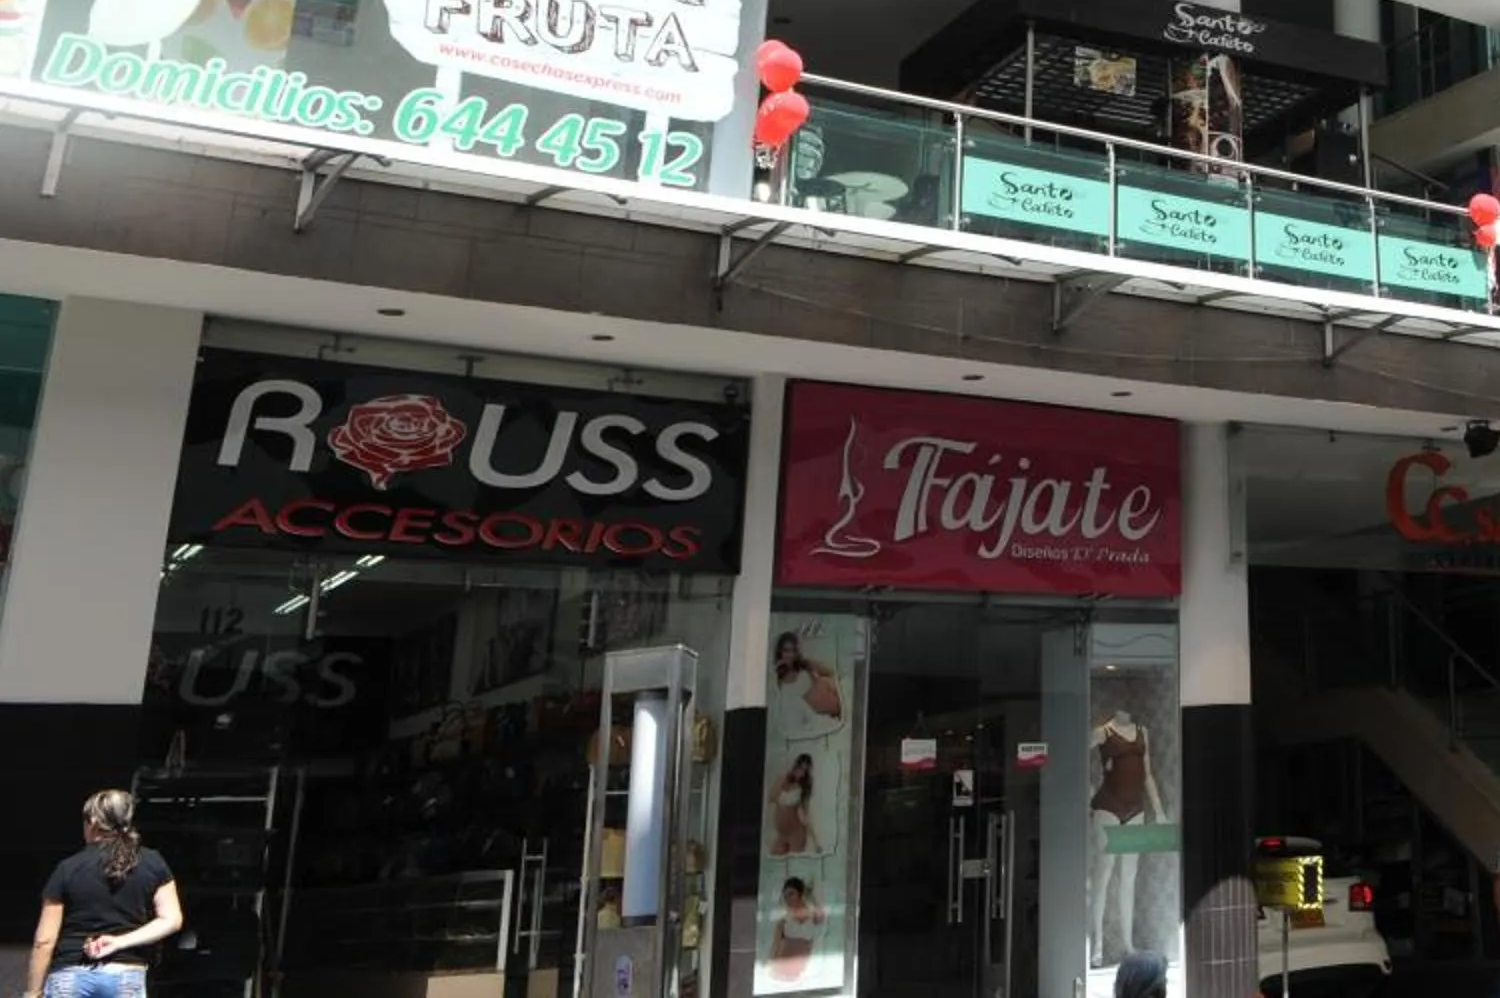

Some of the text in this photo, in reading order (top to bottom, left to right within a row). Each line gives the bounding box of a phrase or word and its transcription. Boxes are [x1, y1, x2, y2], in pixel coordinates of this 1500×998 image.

[1174, 2, 1258, 36] Santo
[1199, 29, 1255, 54] Cafeto
[45, 34, 703, 186] Domicilios: 644 45 12
[1000, 171, 1074, 202] Santo
[1151, 198, 1218, 228] Santo
[1283, 222, 1344, 250] Santo
[1403, 245, 1459, 270] Santo
[883, 436, 1161, 559] Fájate
[212, 497, 702, 560] ACCESORIOS
[201, 605, 244, 636] 112
